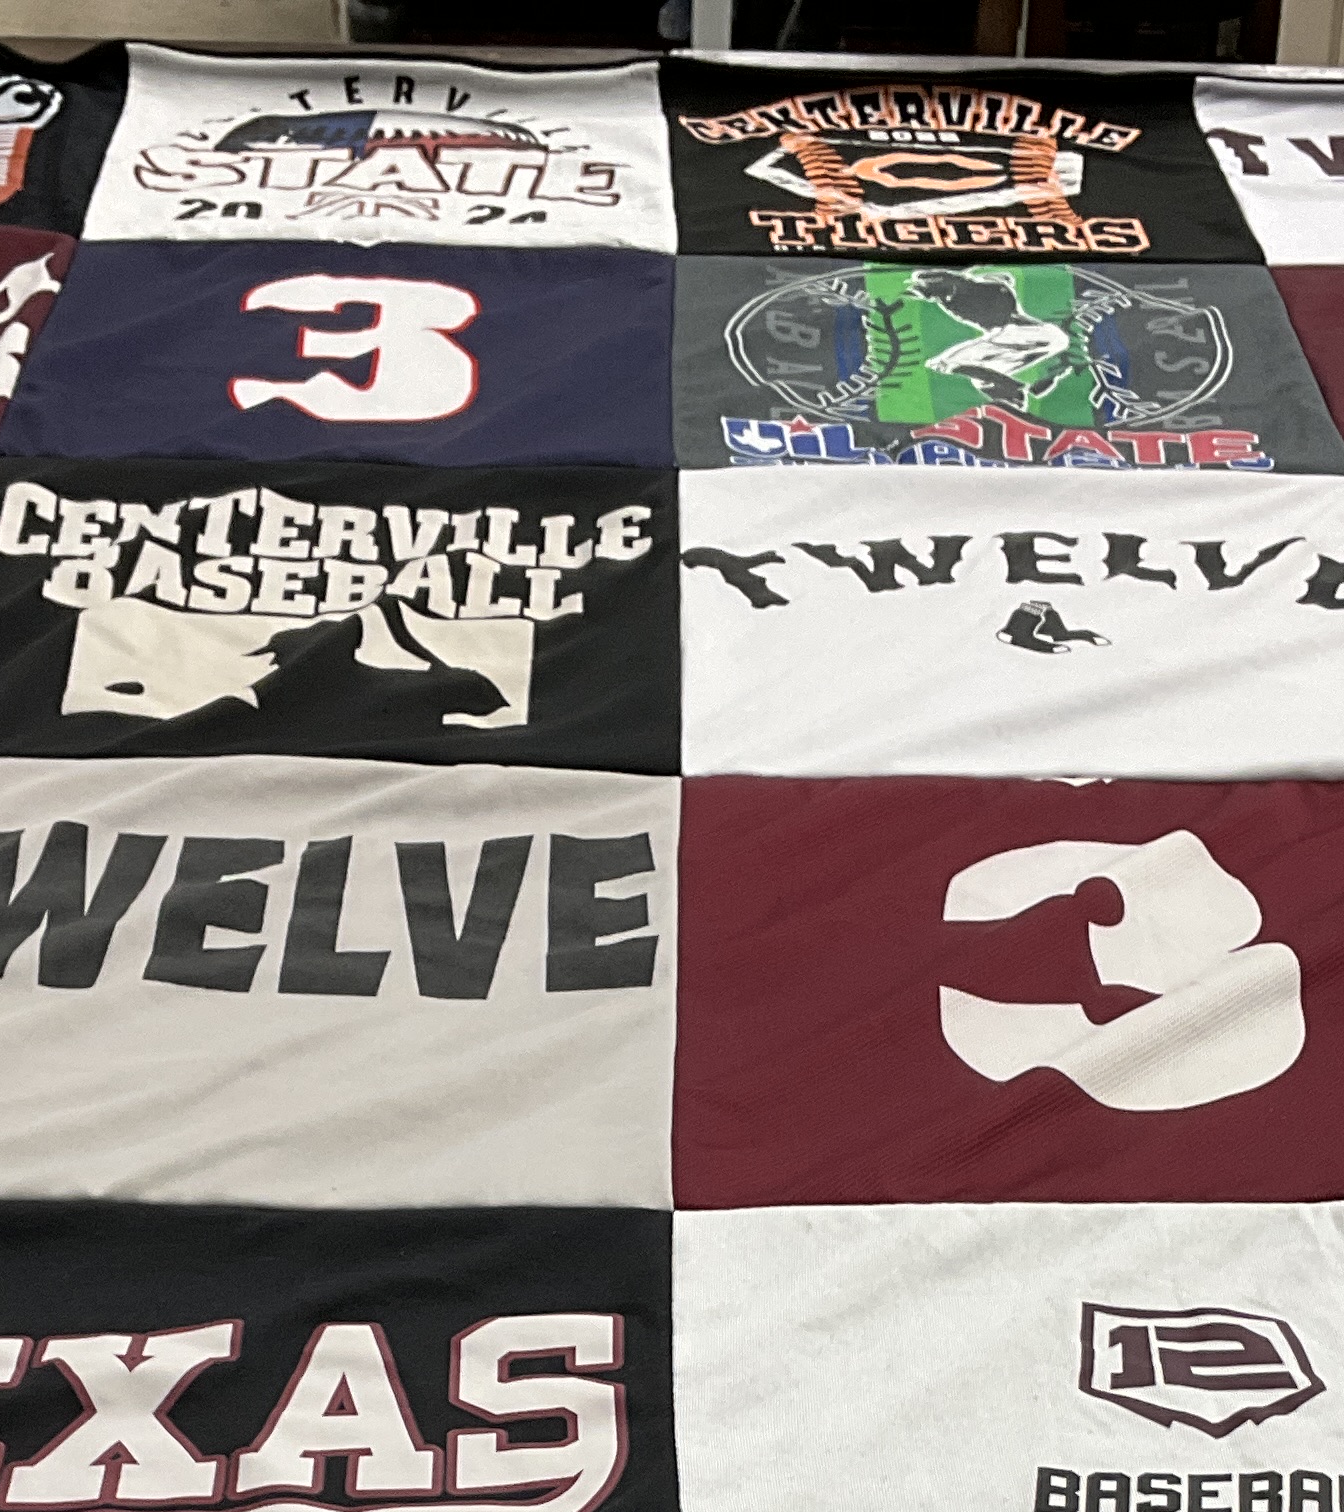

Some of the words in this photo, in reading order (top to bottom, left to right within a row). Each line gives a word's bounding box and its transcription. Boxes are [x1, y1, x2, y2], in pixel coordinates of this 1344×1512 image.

[678, 86, 1141, 151] CENTERVILLE
[134, 146, 621, 207] STATE
[750, 211, 1151, 253] TIGERS
[228, 274, 481, 422] 3
[41, 541, 583, 620] BASEBALL
[939, 829, 1306, 1112] 3
[1109, 1322, 1299, 1390] 12
